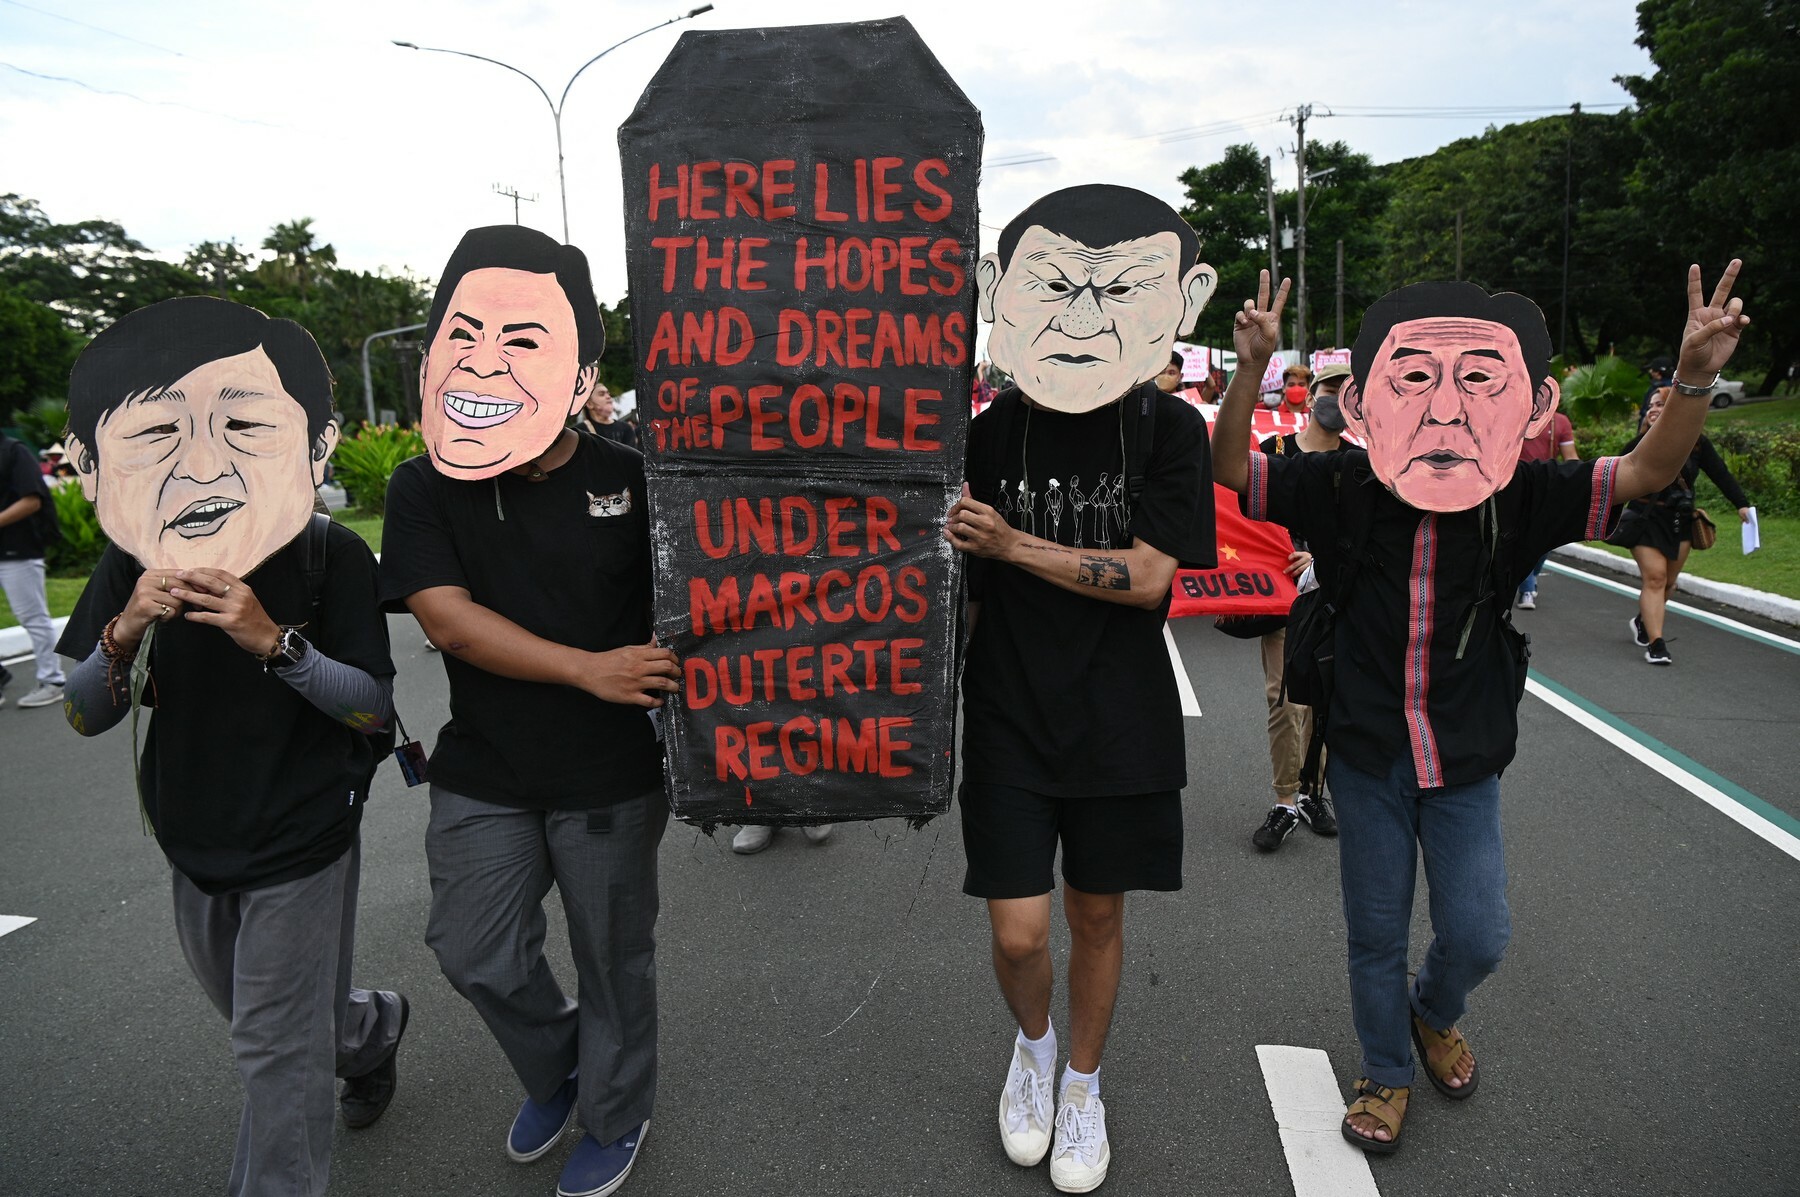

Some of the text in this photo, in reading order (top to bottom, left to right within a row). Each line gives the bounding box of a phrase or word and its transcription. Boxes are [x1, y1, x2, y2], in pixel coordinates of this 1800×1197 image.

[649, 158, 952, 222] HERE LIES
[652, 236, 963, 295] THE HOPES
[646, 307, 966, 371] AND DREAMS
[651, 383, 942, 451] THE PEOPLE
[658, 378, 699, 412] OF
[695, 496, 901, 558] UNDER
[689, 565, 928, 636] MARCOS
[1180, 572, 1275, 598] BULSU
[684, 638, 924, 709] DUTERTE
[716, 716, 912, 781] REGIME
